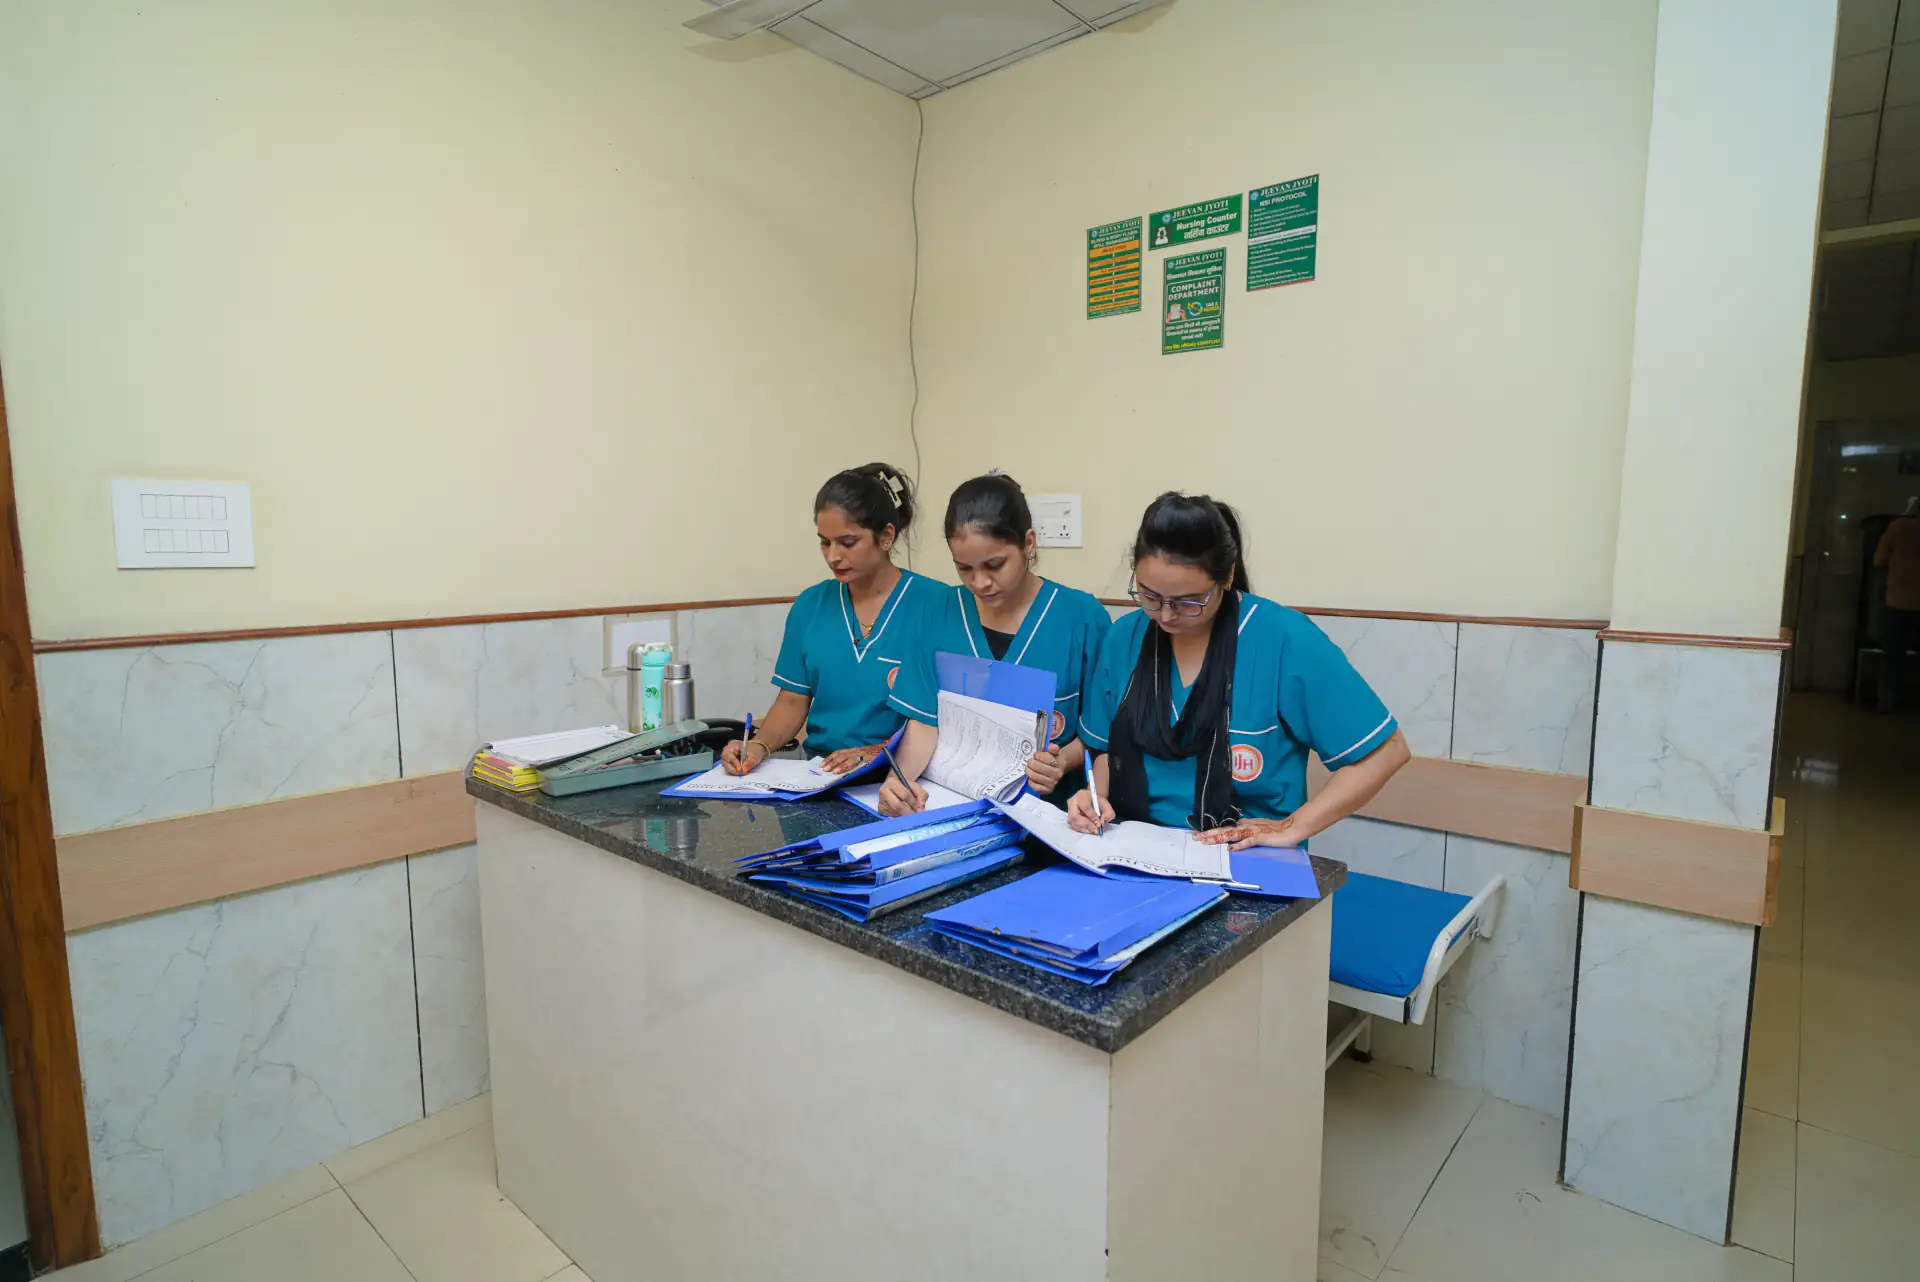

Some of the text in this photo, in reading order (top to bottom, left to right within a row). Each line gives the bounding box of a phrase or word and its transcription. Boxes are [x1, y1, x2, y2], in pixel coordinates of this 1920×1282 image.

[1260, 183, 1292, 197] JEEVAN
[1292, 176, 1318, 189] JYOTI
[1259, 197, 1271, 207] NSI
[1271, 191, 1308, 205] PROTOCOL
[1172, 205, 1203, 219] JEEVAN
[1204, 199, 1229, 212] JYOTI
[1176, 218, 1206, 231] Nursing
[1206, 211, 1239, 225] Counter
[1174, 254, 1201, 266] JEEVAN
[1201, 251, 1223, 262] JYOTI
[1168, 286, 1220, 301] DEPARTMENT
[1171, 279, 1217, 294] COMPLAINT
